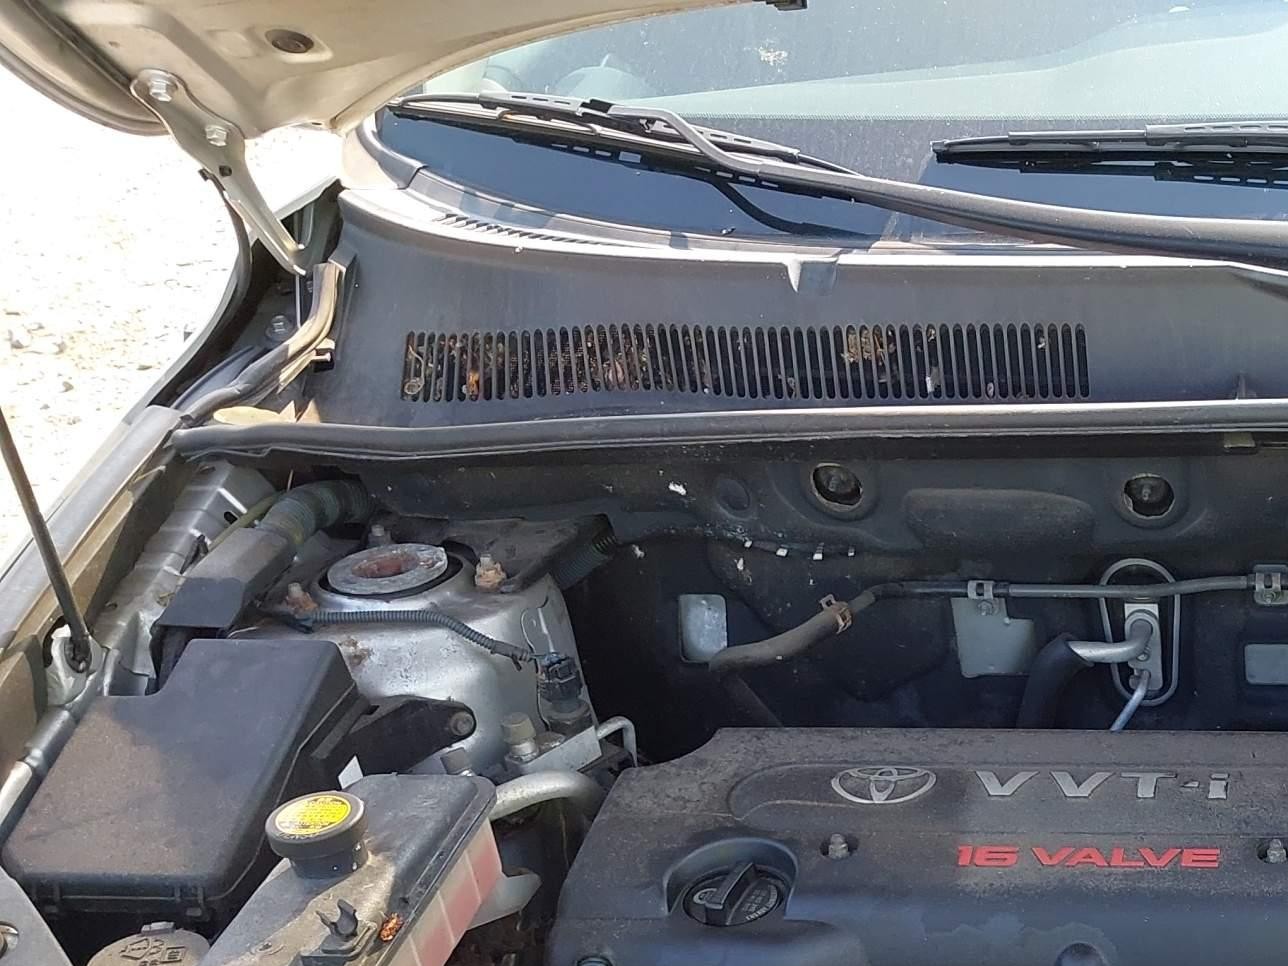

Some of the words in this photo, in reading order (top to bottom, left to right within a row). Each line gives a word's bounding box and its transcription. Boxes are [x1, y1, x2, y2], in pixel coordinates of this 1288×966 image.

[975, 770, 1230, 799] VVT-i
[958, 845, 1019, 868] 16
[1032, 847, 1221, 869] VALVE
